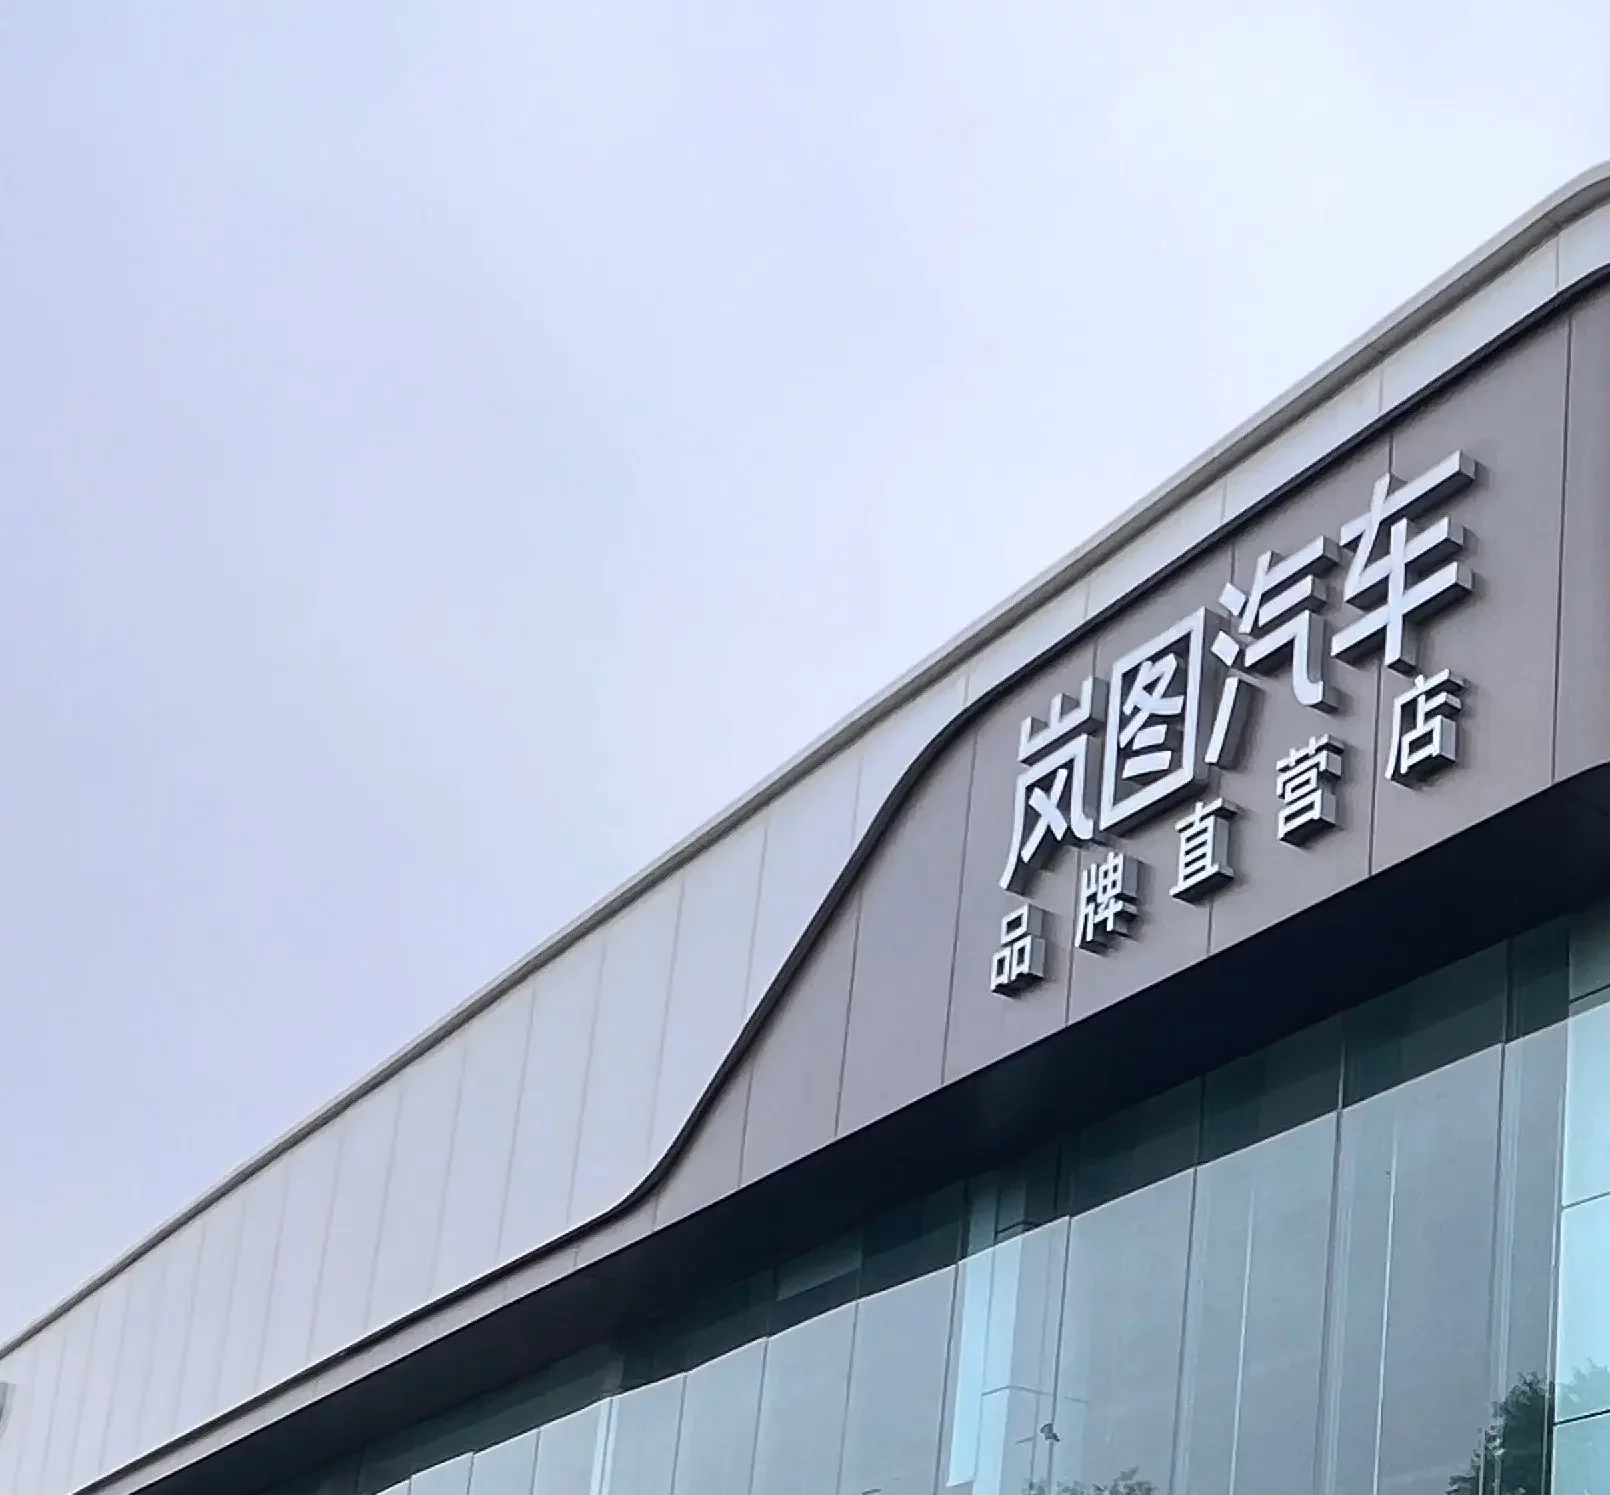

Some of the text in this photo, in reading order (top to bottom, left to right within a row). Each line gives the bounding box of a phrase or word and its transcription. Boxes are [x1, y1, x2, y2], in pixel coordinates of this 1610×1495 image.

[990, 669, 1464, 998] 品牌直营店
[998, 449, 1477, 893] 岚图汽车
